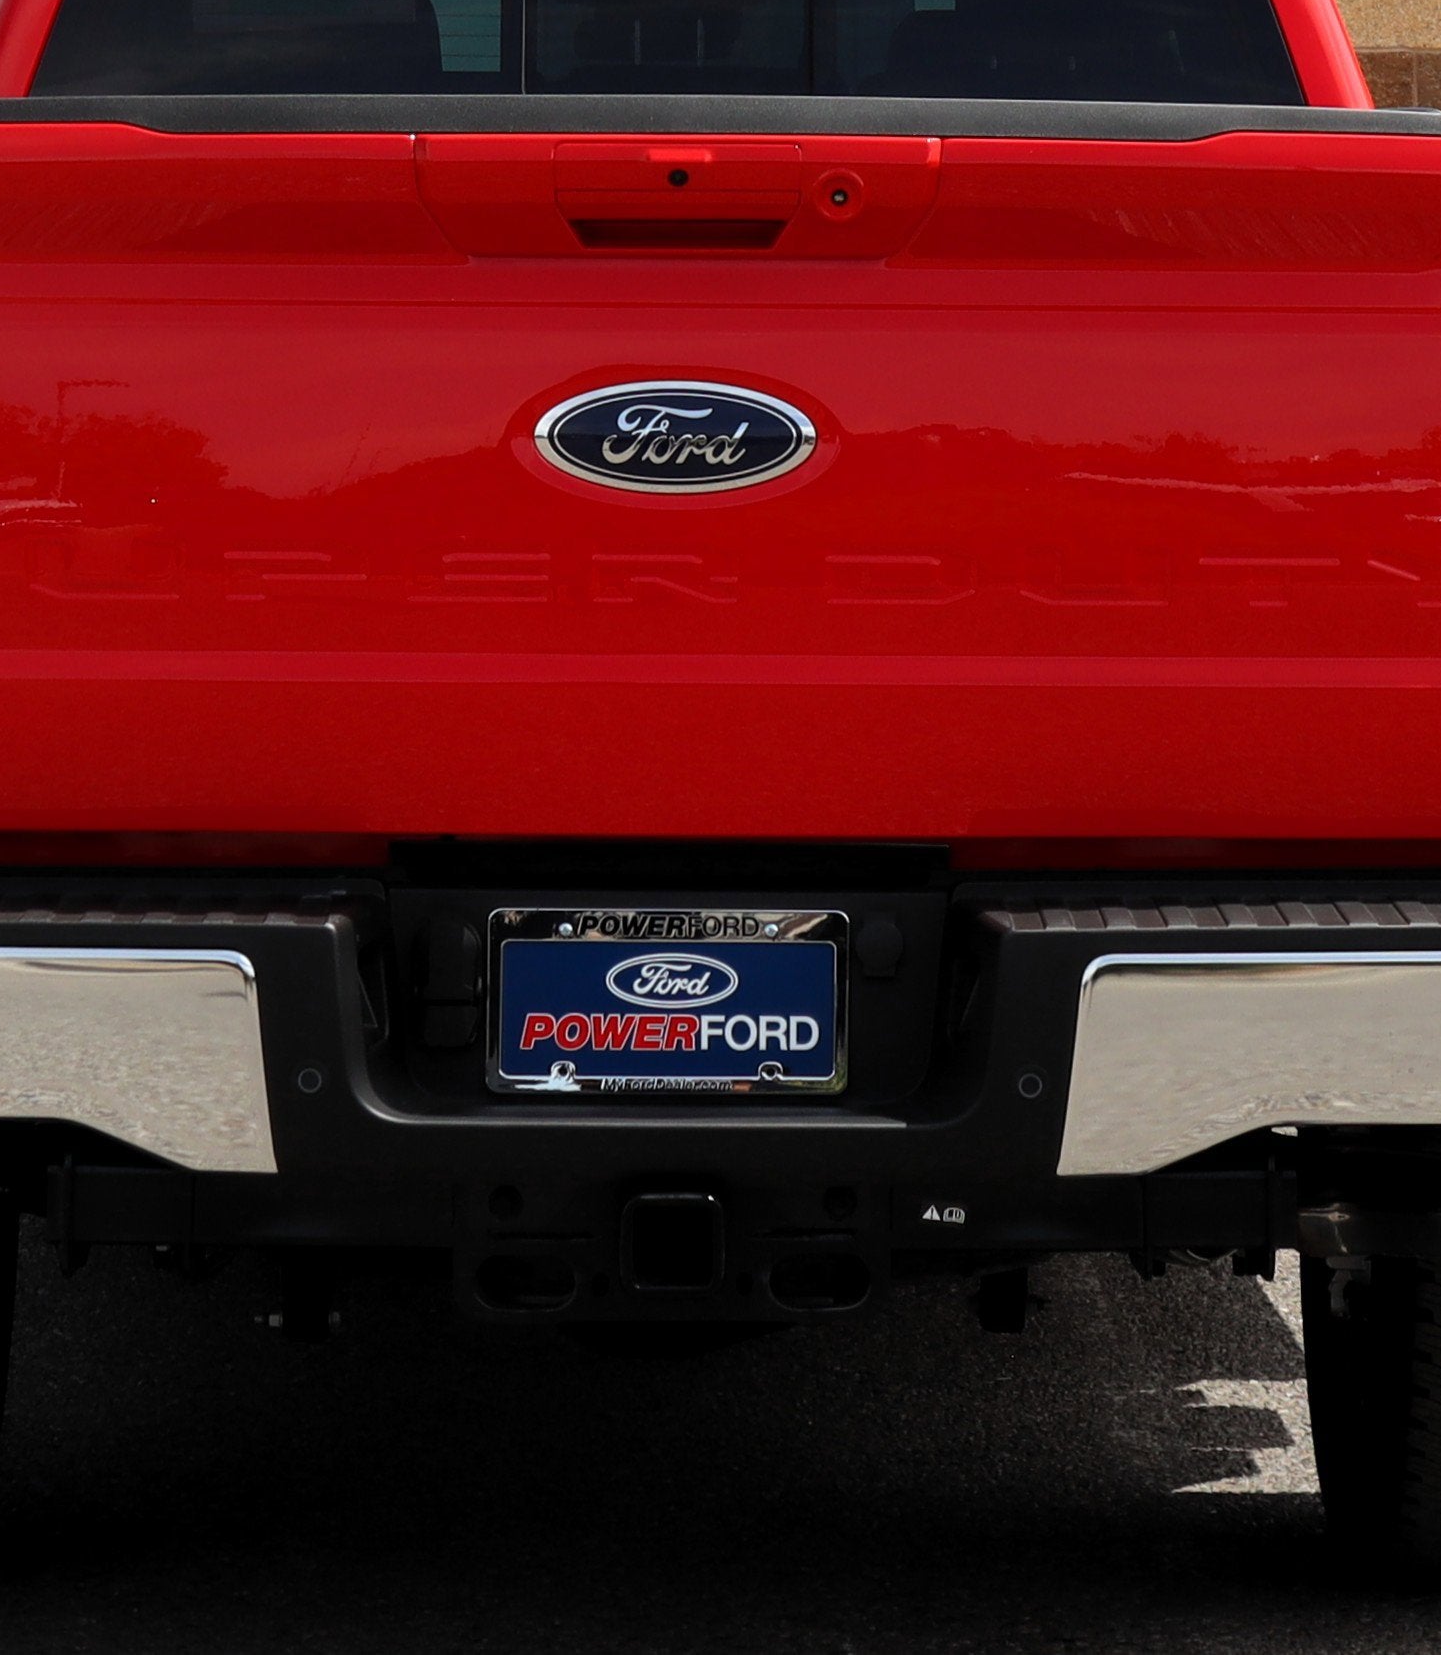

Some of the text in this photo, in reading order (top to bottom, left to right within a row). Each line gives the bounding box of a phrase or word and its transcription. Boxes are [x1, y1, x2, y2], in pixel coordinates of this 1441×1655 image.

[601, 403, 750, 466] Ford
[578, 914, 760, 938] POWERFORD
[631, 961, 712, 996] Ford
[520, 1012, 820, 1052] POWERFORD
